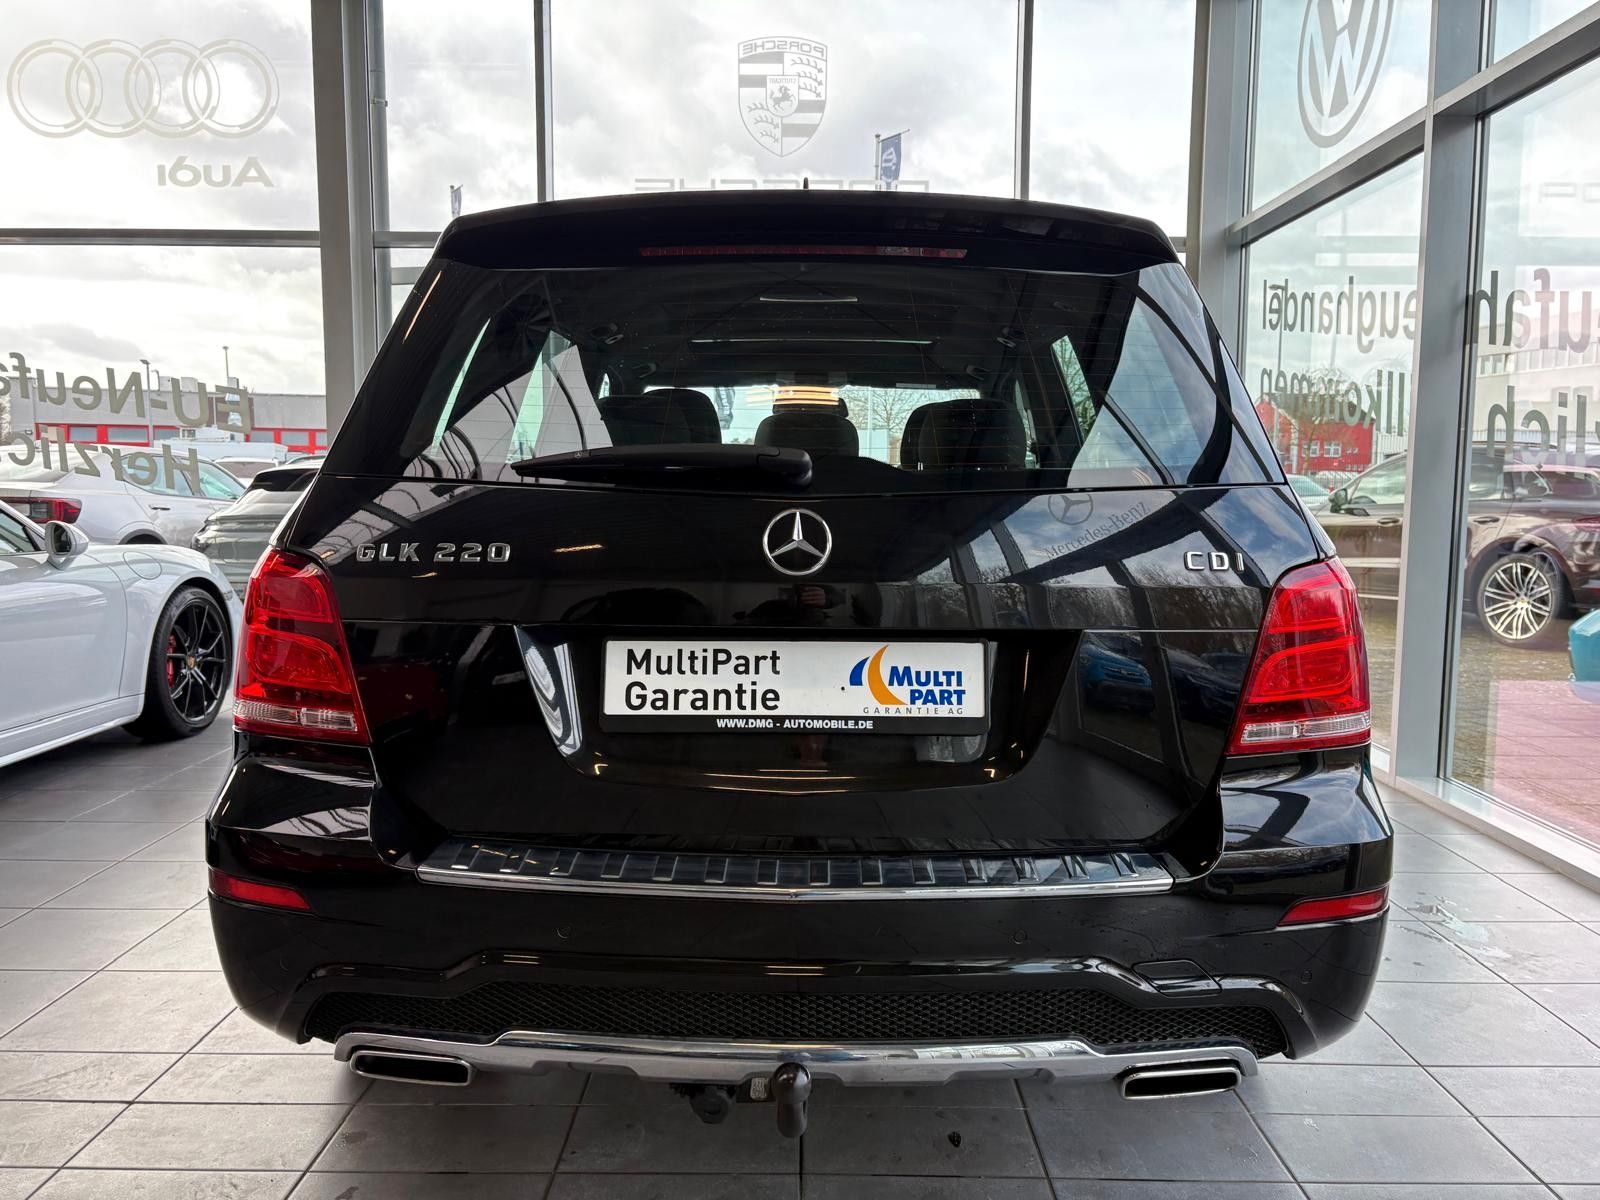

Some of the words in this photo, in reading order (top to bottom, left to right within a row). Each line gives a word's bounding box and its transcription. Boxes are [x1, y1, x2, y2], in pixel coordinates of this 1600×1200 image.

[1043, 501, 1151, 559] Mercedes-Benz
[356, 542, 420, 563] GLK
[433, 542, 512, 563] 220
[1184, 551, 1245, 573] CDI
[626, 648, 781, 675] MultiPart
[888, 666, 963, 687] MULTI
[625, 681, 781, 711] Garantie
[910, 689, 966, 706] PART
[863, 706, 940, 715] GARANTIE
[947, 707, 964, 715] AG
[716, 718, 774, 729] WWW.DMG
[783, 719, 874, 729] AUTOMOBILE.DE
